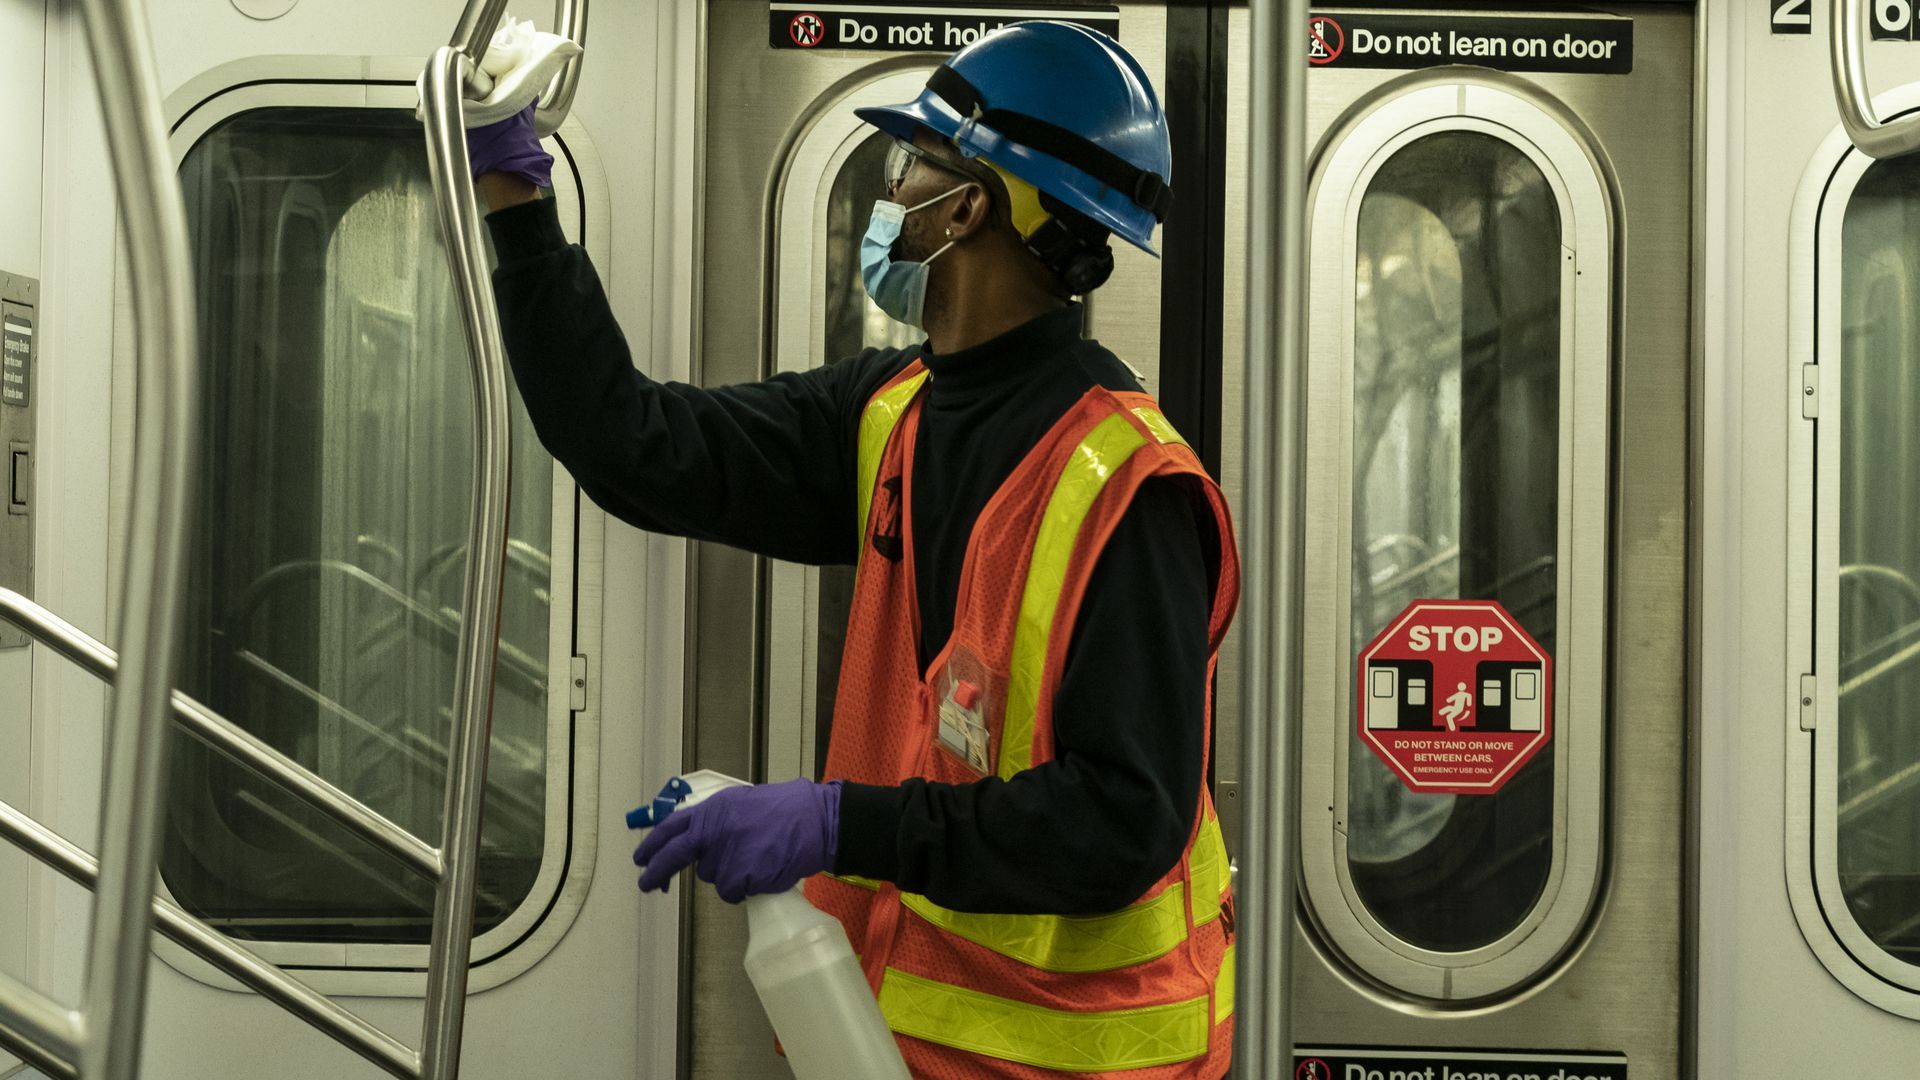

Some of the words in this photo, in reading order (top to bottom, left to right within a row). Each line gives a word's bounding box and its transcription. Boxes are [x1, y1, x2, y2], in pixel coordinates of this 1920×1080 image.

[839, 18, 878, 44] Do
[888, 22, 933, 46] not
[1352, 28, 1391, 54] Do
[1396, 31, 1442, 55] not
[1449, 30, 1506, 56] lean
[1512, 37, 1547, 58] on
[1552, 33, 1617, 59] door
[1408, 625, 1503, 652] STOP
[1394, 740, 1410, 749] DO
[1411, 740, 1432, 750] NOT
[1433, 741, 1467, 751] STAND
[1468, 741, 1483, 751] OR
[1484, 741, 1514, 751] MOVE
[1413, 753, 1462, 762] BETWEEN
[1463, 753, 1494, 763] CARS.
[1413, 766, 1458, 774] EMERGENCY
[1345, 1063, 1385, 1080] Do
